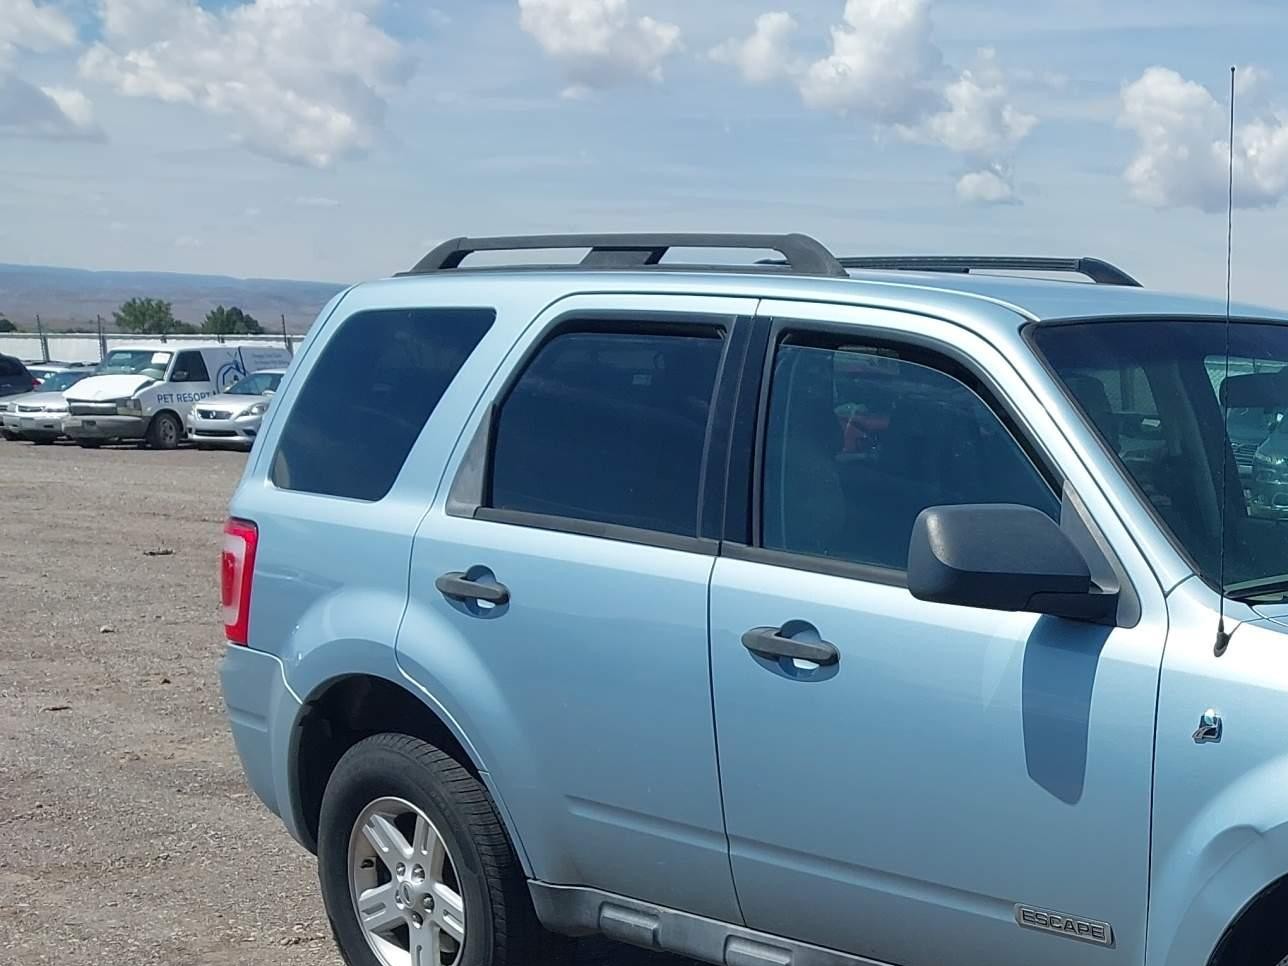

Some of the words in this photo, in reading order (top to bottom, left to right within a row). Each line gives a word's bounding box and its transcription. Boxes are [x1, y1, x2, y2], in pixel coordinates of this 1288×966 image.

[156, 393, 174, 404] PET
[176, 391, 210, 403] RESORT
[1021, 908, 1106, 941] ESCAPE
